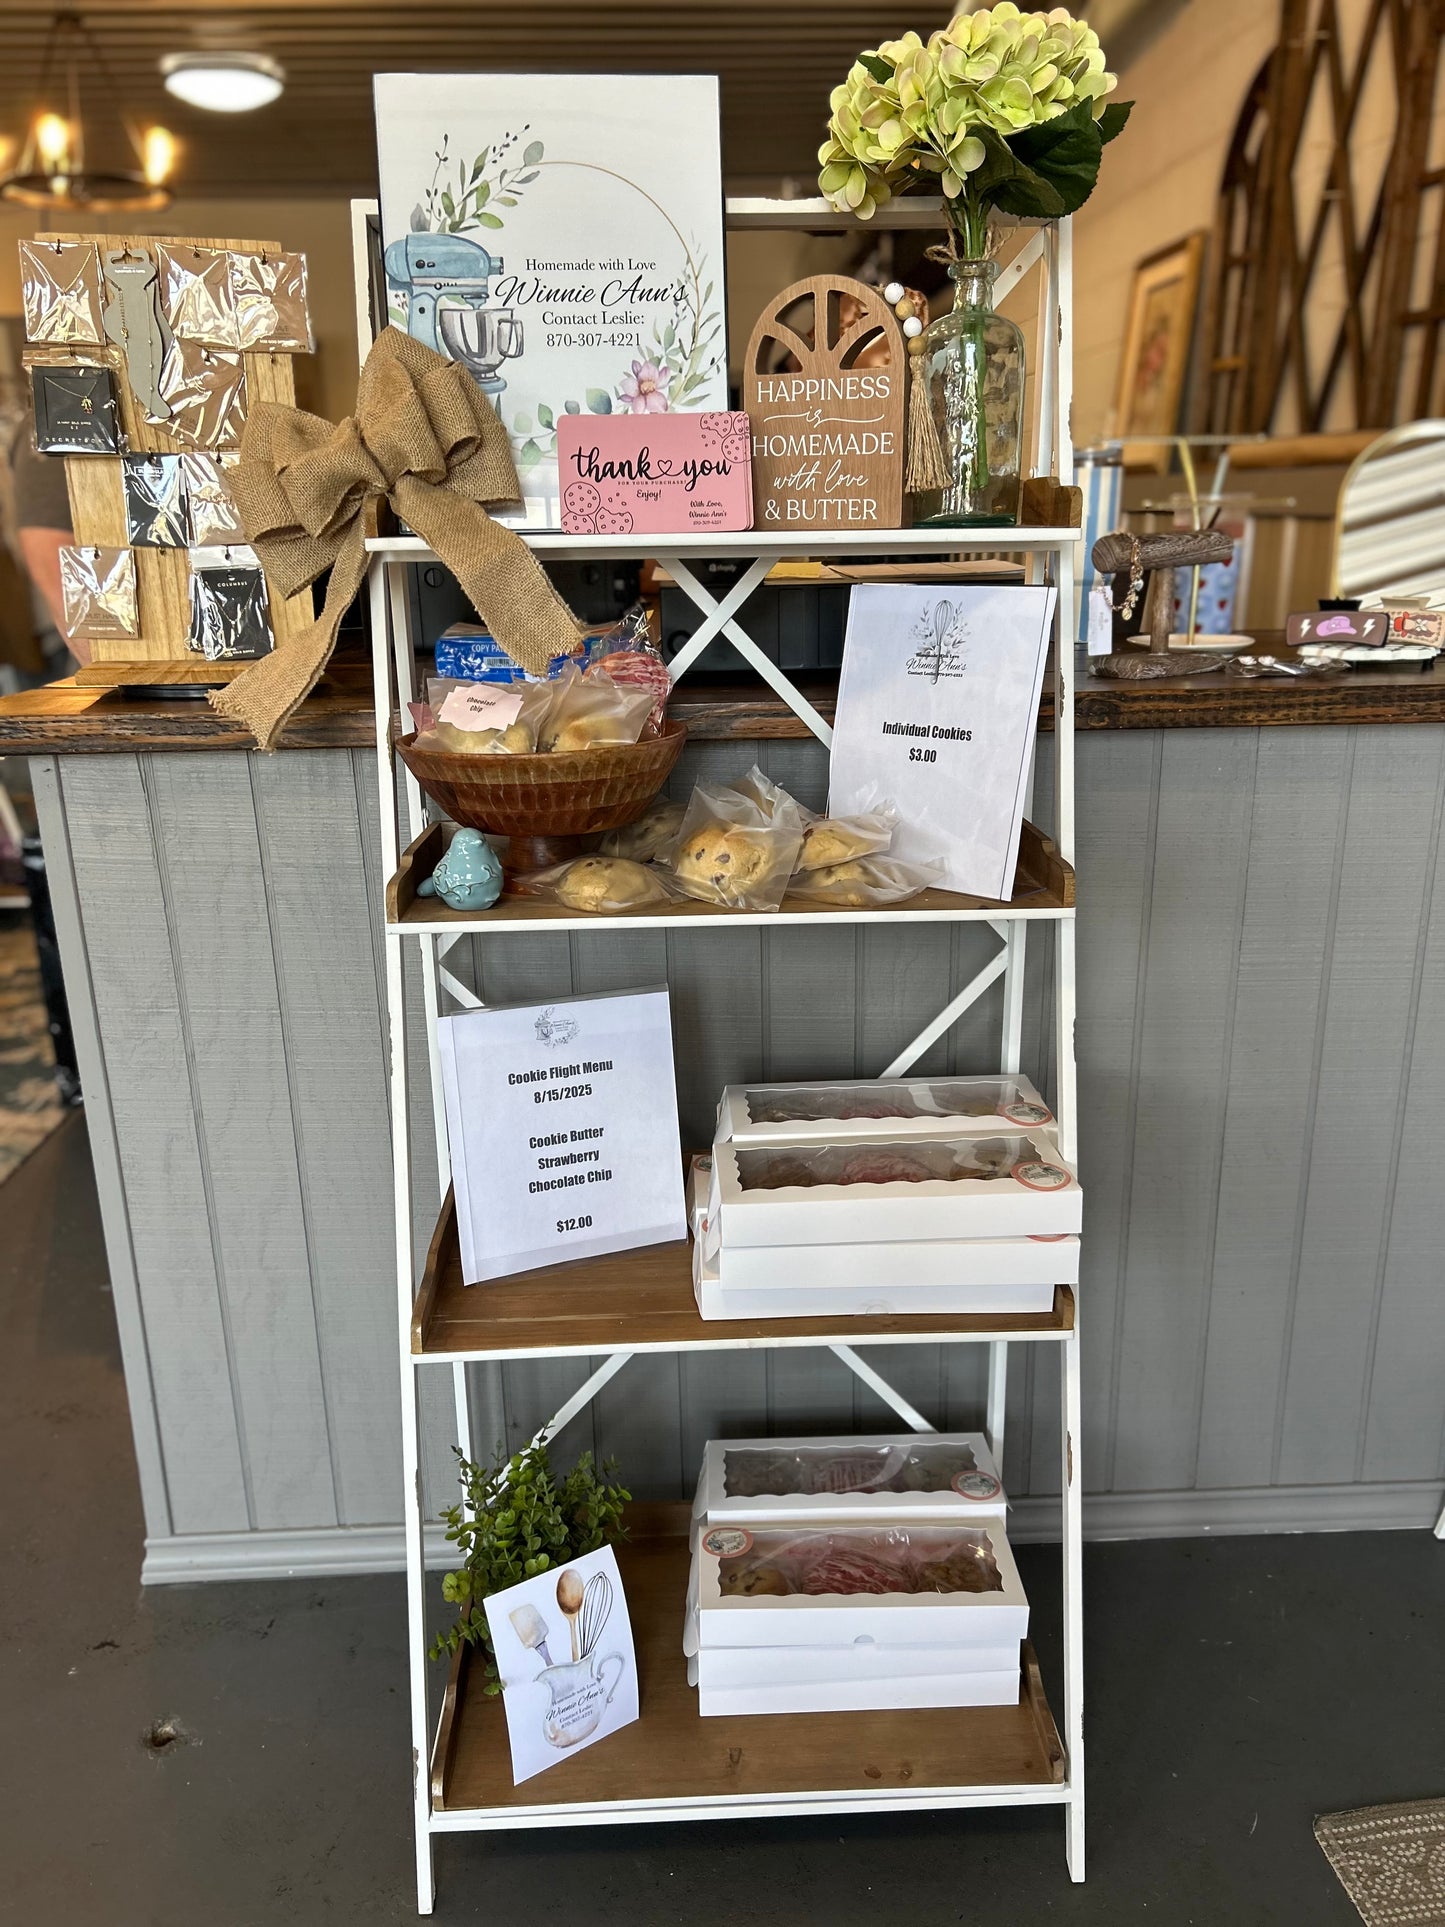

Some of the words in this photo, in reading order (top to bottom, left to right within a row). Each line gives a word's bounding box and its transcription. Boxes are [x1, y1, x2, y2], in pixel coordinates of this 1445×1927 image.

[525, 259, 595, 271] Homemade
[598, 259, 624, 271] with
[628, 259, 657, 271] Love
[495, 275, 596, 307] Winnie
[600, 274, 690, 307] Ann's
[542, 311, 598, 325] Contact
[601, 311, 645, 325] Leslie:
[546, 332, 642, 347] 870-307-4221
[757, 375, 890, 403] HAPPINESS
[752, 432, 894, 457] HOMEMADE
[571, 446, 652, 483] thank
[683, 458, 732, 492] you
[773, 460, 822, 492] with
[824, 459, 869, 493] love
[637, 489, 662, 501] Enjoy!
[690, 500, 705, 508] With
[706, 500, 722, 508] Love,
[689, 511, 710, 519] Winnie
[711, 510, 727, 518] Ann's
[765, 499, 781, 520] &
[786, 498, 878, 520] BUTTER
[471, 644, 490, 653] COPY
[906, 658, 938, 671] Winnie
[938, 658, 968, 672] Ann's
[882, 721, 931, 738] Individual
[932, 725, 973, 742] Cookies
[908, 747, 937, 763] $3.00
[508, 1068, 547, 1085] Cookie
[549, 1063, 581, 1079] Flight
[583, 1059, 613, 1074] Menu
[533, 1083, 593, 1104] 8/15/2025
[529, 1131, 568, 1149] Cookie
[570, 1126, 604, 1142] Butter
[537, 1150, 600, 1170] Strawberry
[528, 1174, 585, 1194] Chocolate
[587, 1169, 613, 1185] Chip
[556, 1215, 593, 1234] $12.00
[545, 1702, 577, 1721] Winnie
[578, 1687, 605, 1706] Ann's
[559, 1712, 578, 1723] Contact
